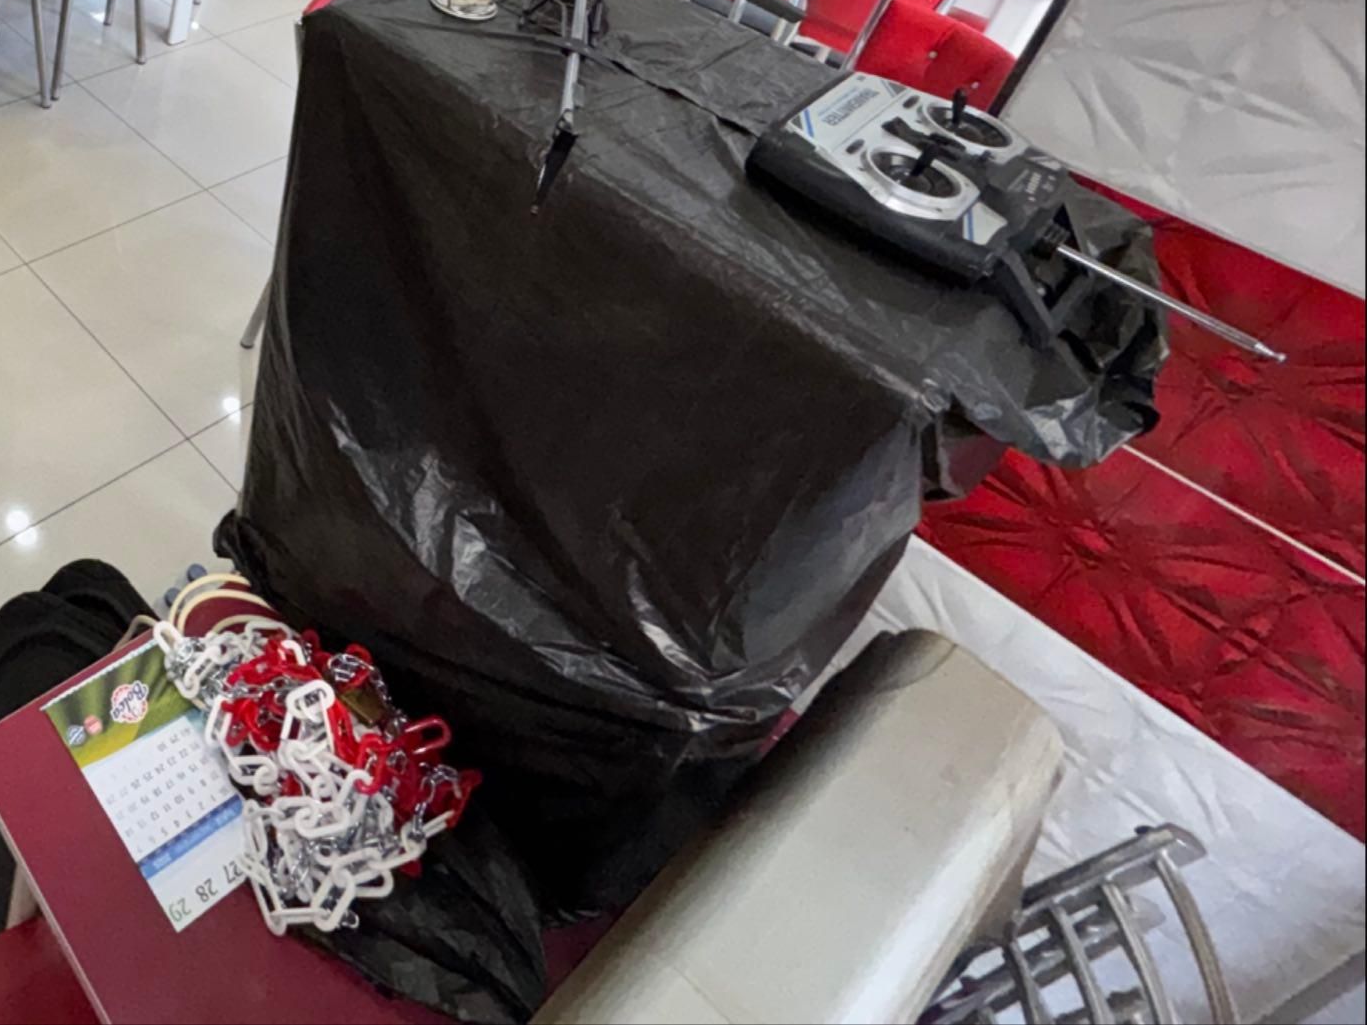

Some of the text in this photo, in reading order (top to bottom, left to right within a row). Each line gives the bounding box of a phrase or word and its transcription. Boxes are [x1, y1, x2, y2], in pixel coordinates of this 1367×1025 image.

[110, 681, 148, 719] Bolca
[195, 878, 219, 902] 28
[168, 898, 193, 922] 29
